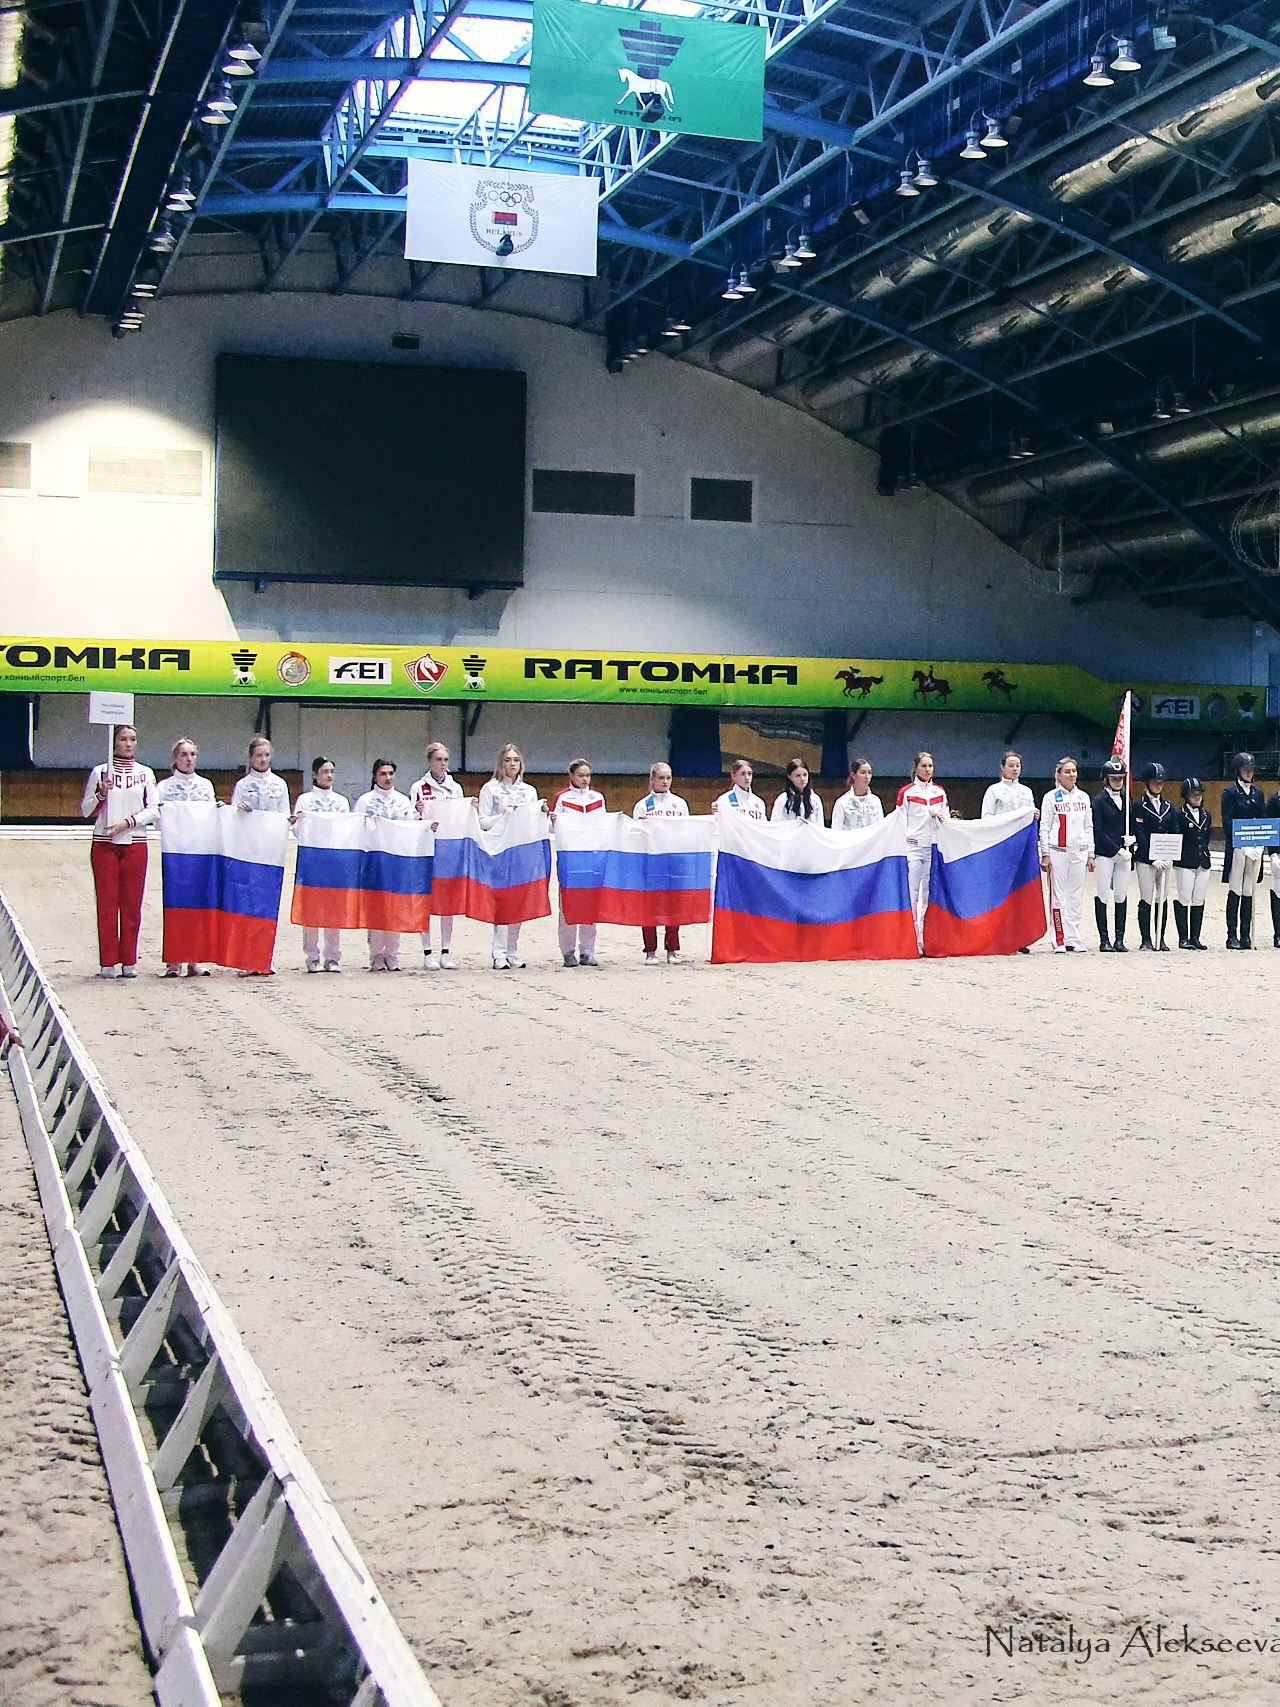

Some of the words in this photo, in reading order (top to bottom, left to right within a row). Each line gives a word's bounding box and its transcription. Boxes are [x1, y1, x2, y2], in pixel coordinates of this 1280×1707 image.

[333, 662, 384, 679] FEI
[524, 658, 798, 685] RATOMKA
[1155, 699, 1194, 714] FEI
